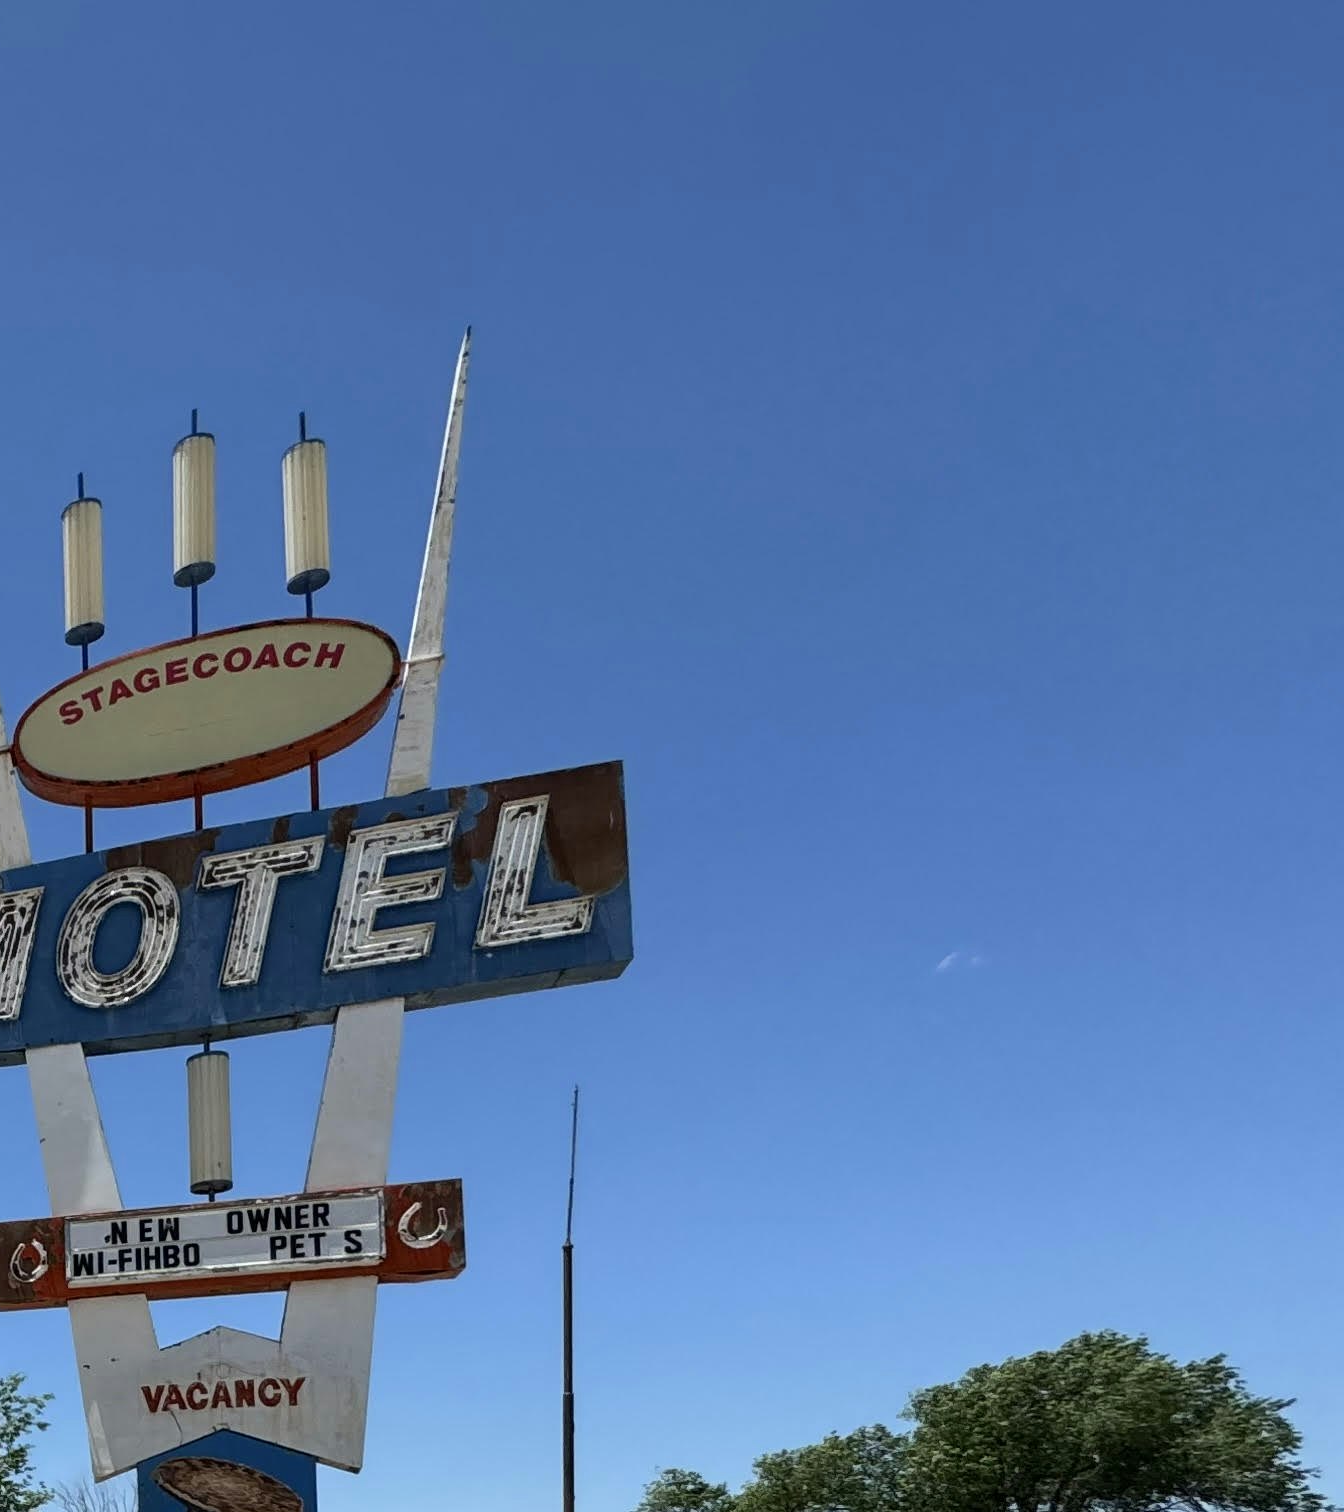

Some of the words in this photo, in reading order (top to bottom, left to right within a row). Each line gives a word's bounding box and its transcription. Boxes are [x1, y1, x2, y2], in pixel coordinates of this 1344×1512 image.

[58, 641, 346, 726] STAGECOACH
[226, 1202, 331, 1236] OWNER
[140, 1375, 307, 1415] VACANCY
